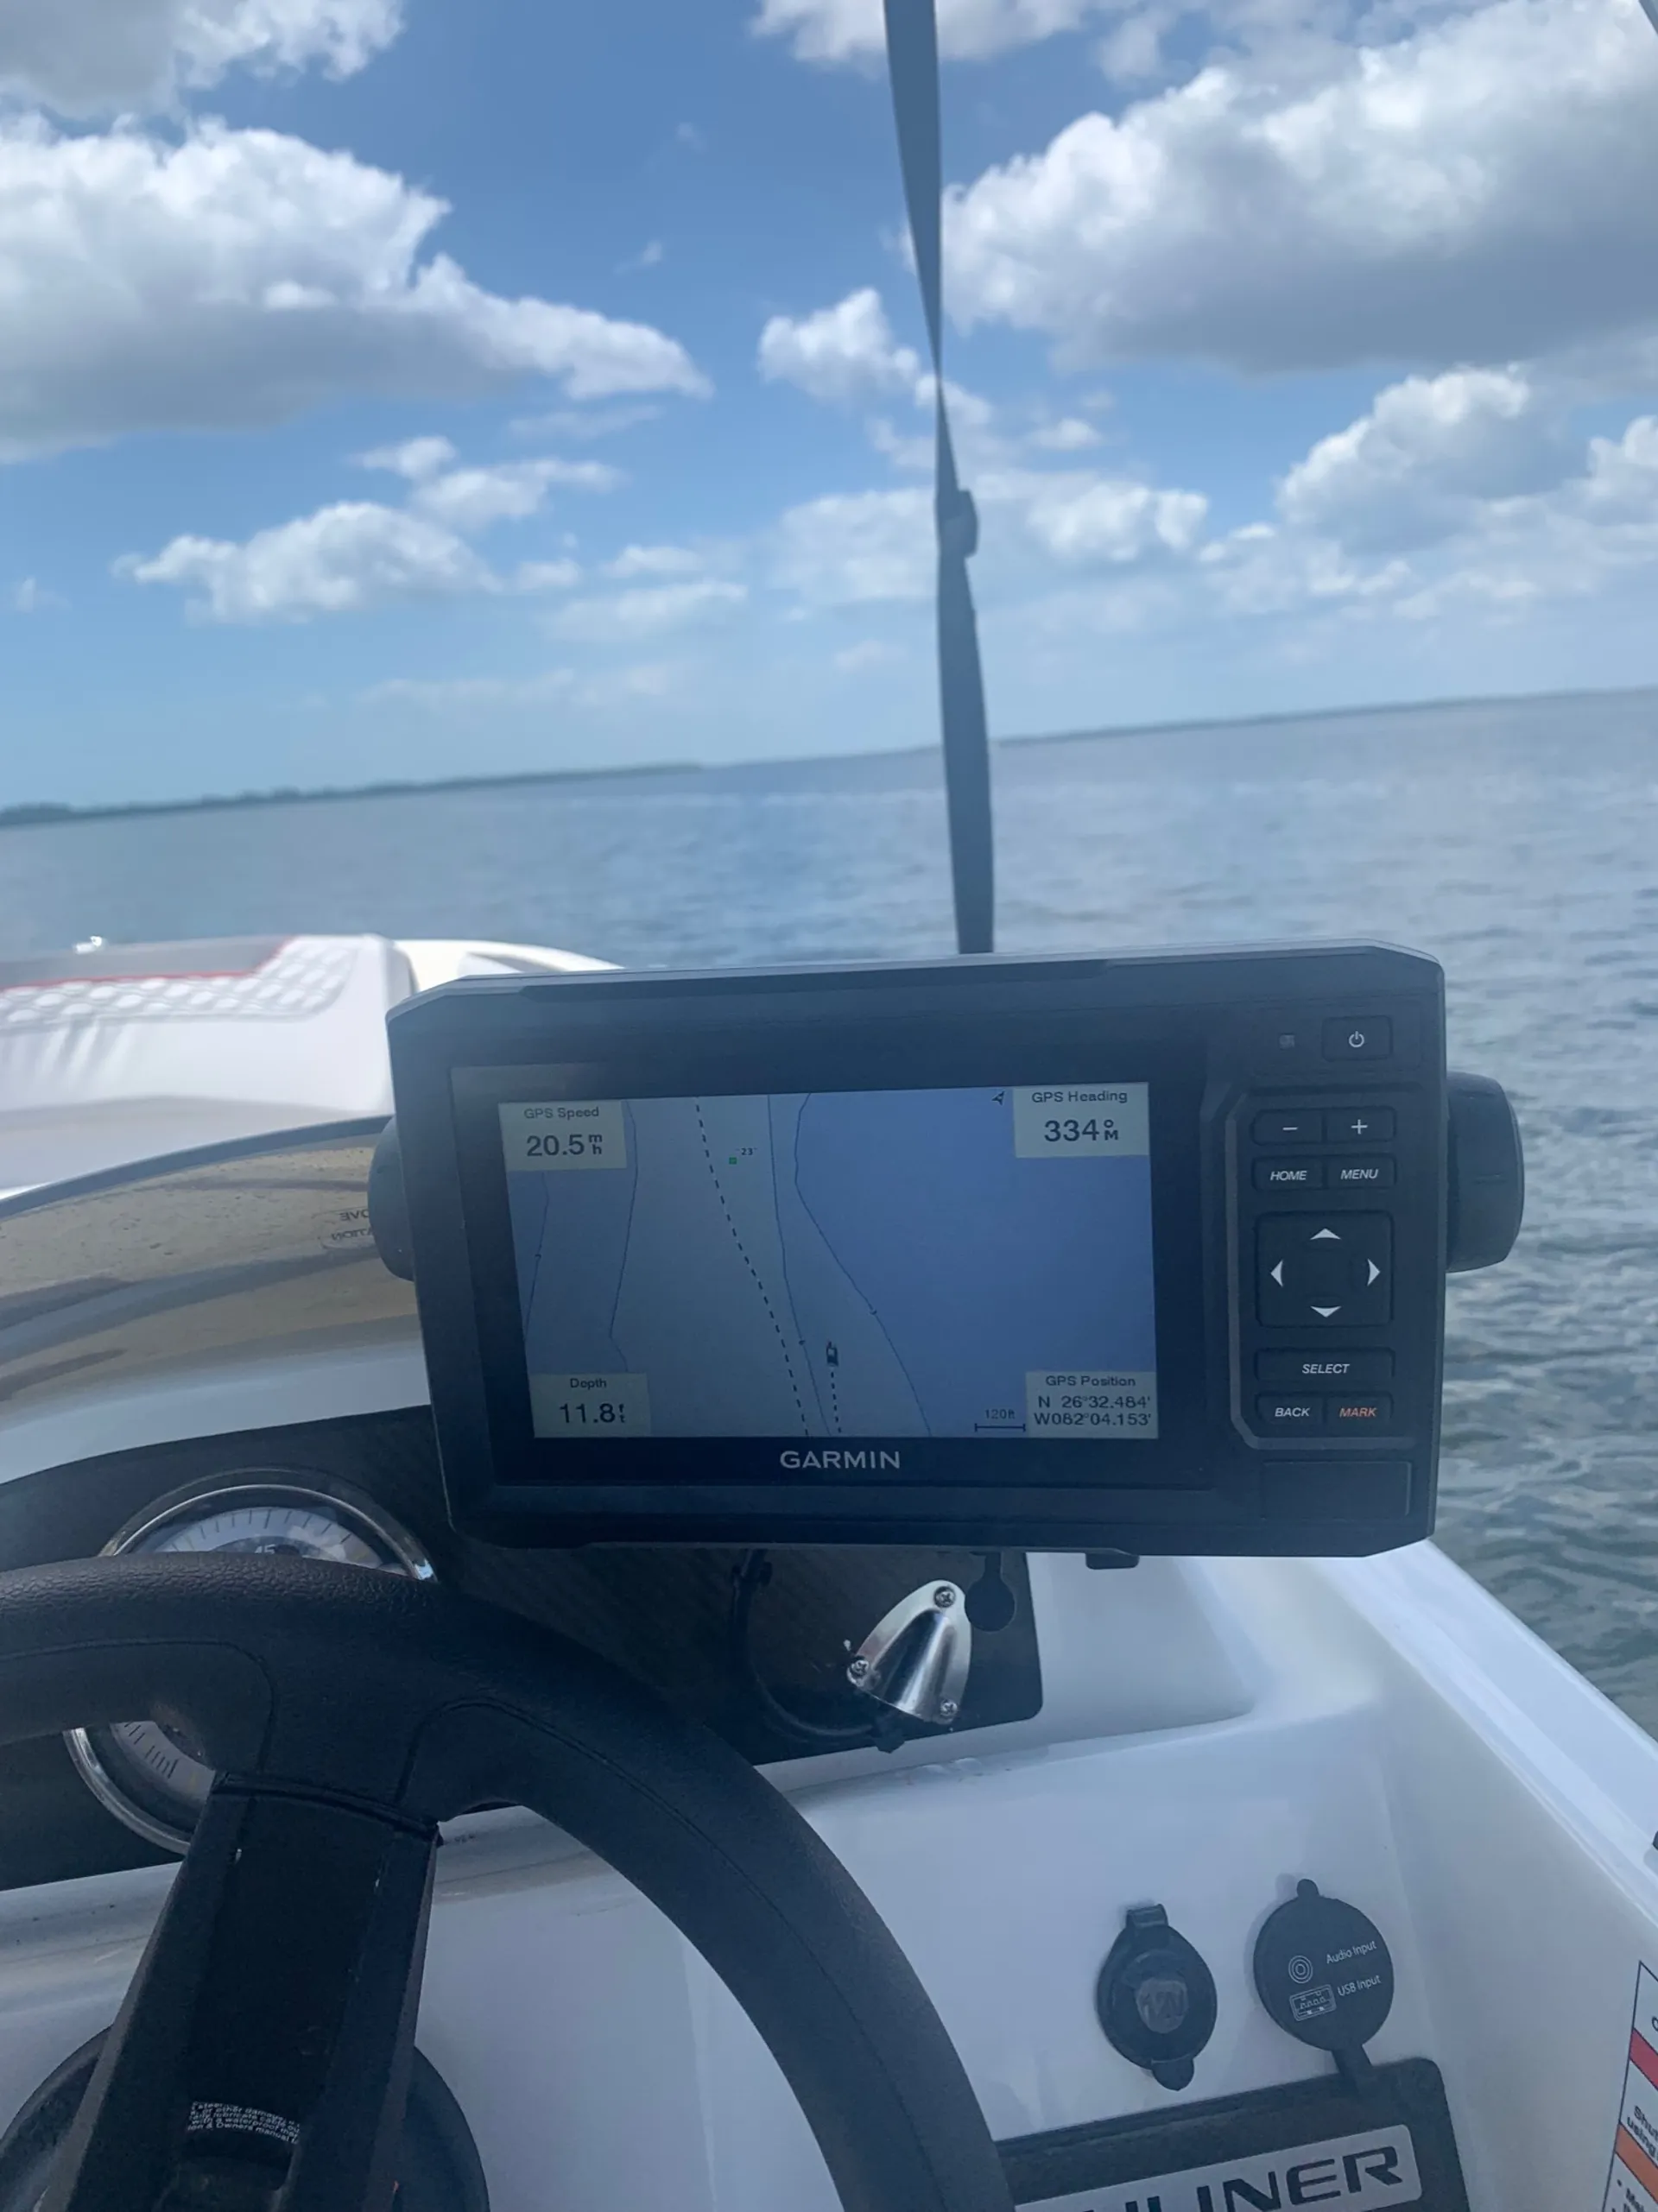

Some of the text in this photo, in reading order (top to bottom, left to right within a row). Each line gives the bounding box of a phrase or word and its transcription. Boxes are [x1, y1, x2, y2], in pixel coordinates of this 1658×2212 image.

[1031, 1090, 1128, 1104] GPS Heading
[523, 1106, 599, 1121] GPS Speed
[526, 1134, 585, 1157] 20.5
[1269, 1168, 1379, 1181] HOME MENU
[1301, 1363, 1351, 1375] SELECT
[569, 1377, 607, 1391] Depth
[1045, 1375, 1136, 1387] GPS Position
[1038, 1395, 1051, 1409] N
[1275, 1406, 1377, 1418] BACK MARK
[779, 1450, 901, 1469] GARMIN
[1326, 1940, 1377, 1964] Audio Input
[1337, 1975, 1382, 1996] USB Input
